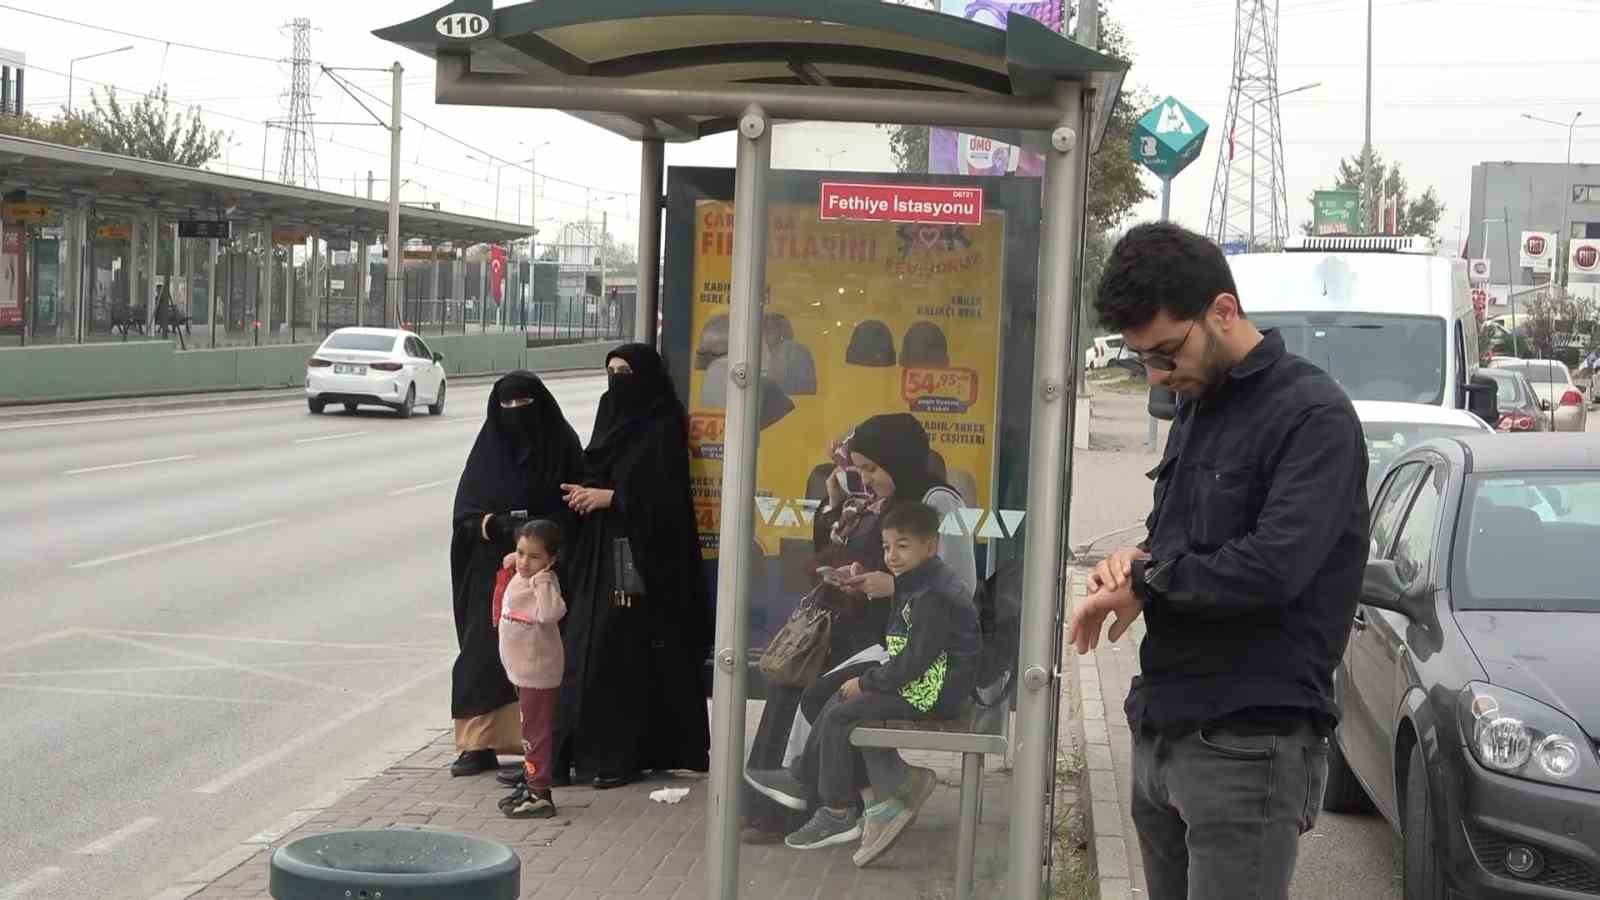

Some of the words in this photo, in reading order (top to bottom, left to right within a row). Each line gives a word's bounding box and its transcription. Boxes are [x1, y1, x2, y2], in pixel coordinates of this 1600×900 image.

[442, 16, 483, 35] 110
[969, 138, 993, 152] OMO
[829, 195, 889, 215] Fethiye
[893, 194, 974, 217] İstasyonu
